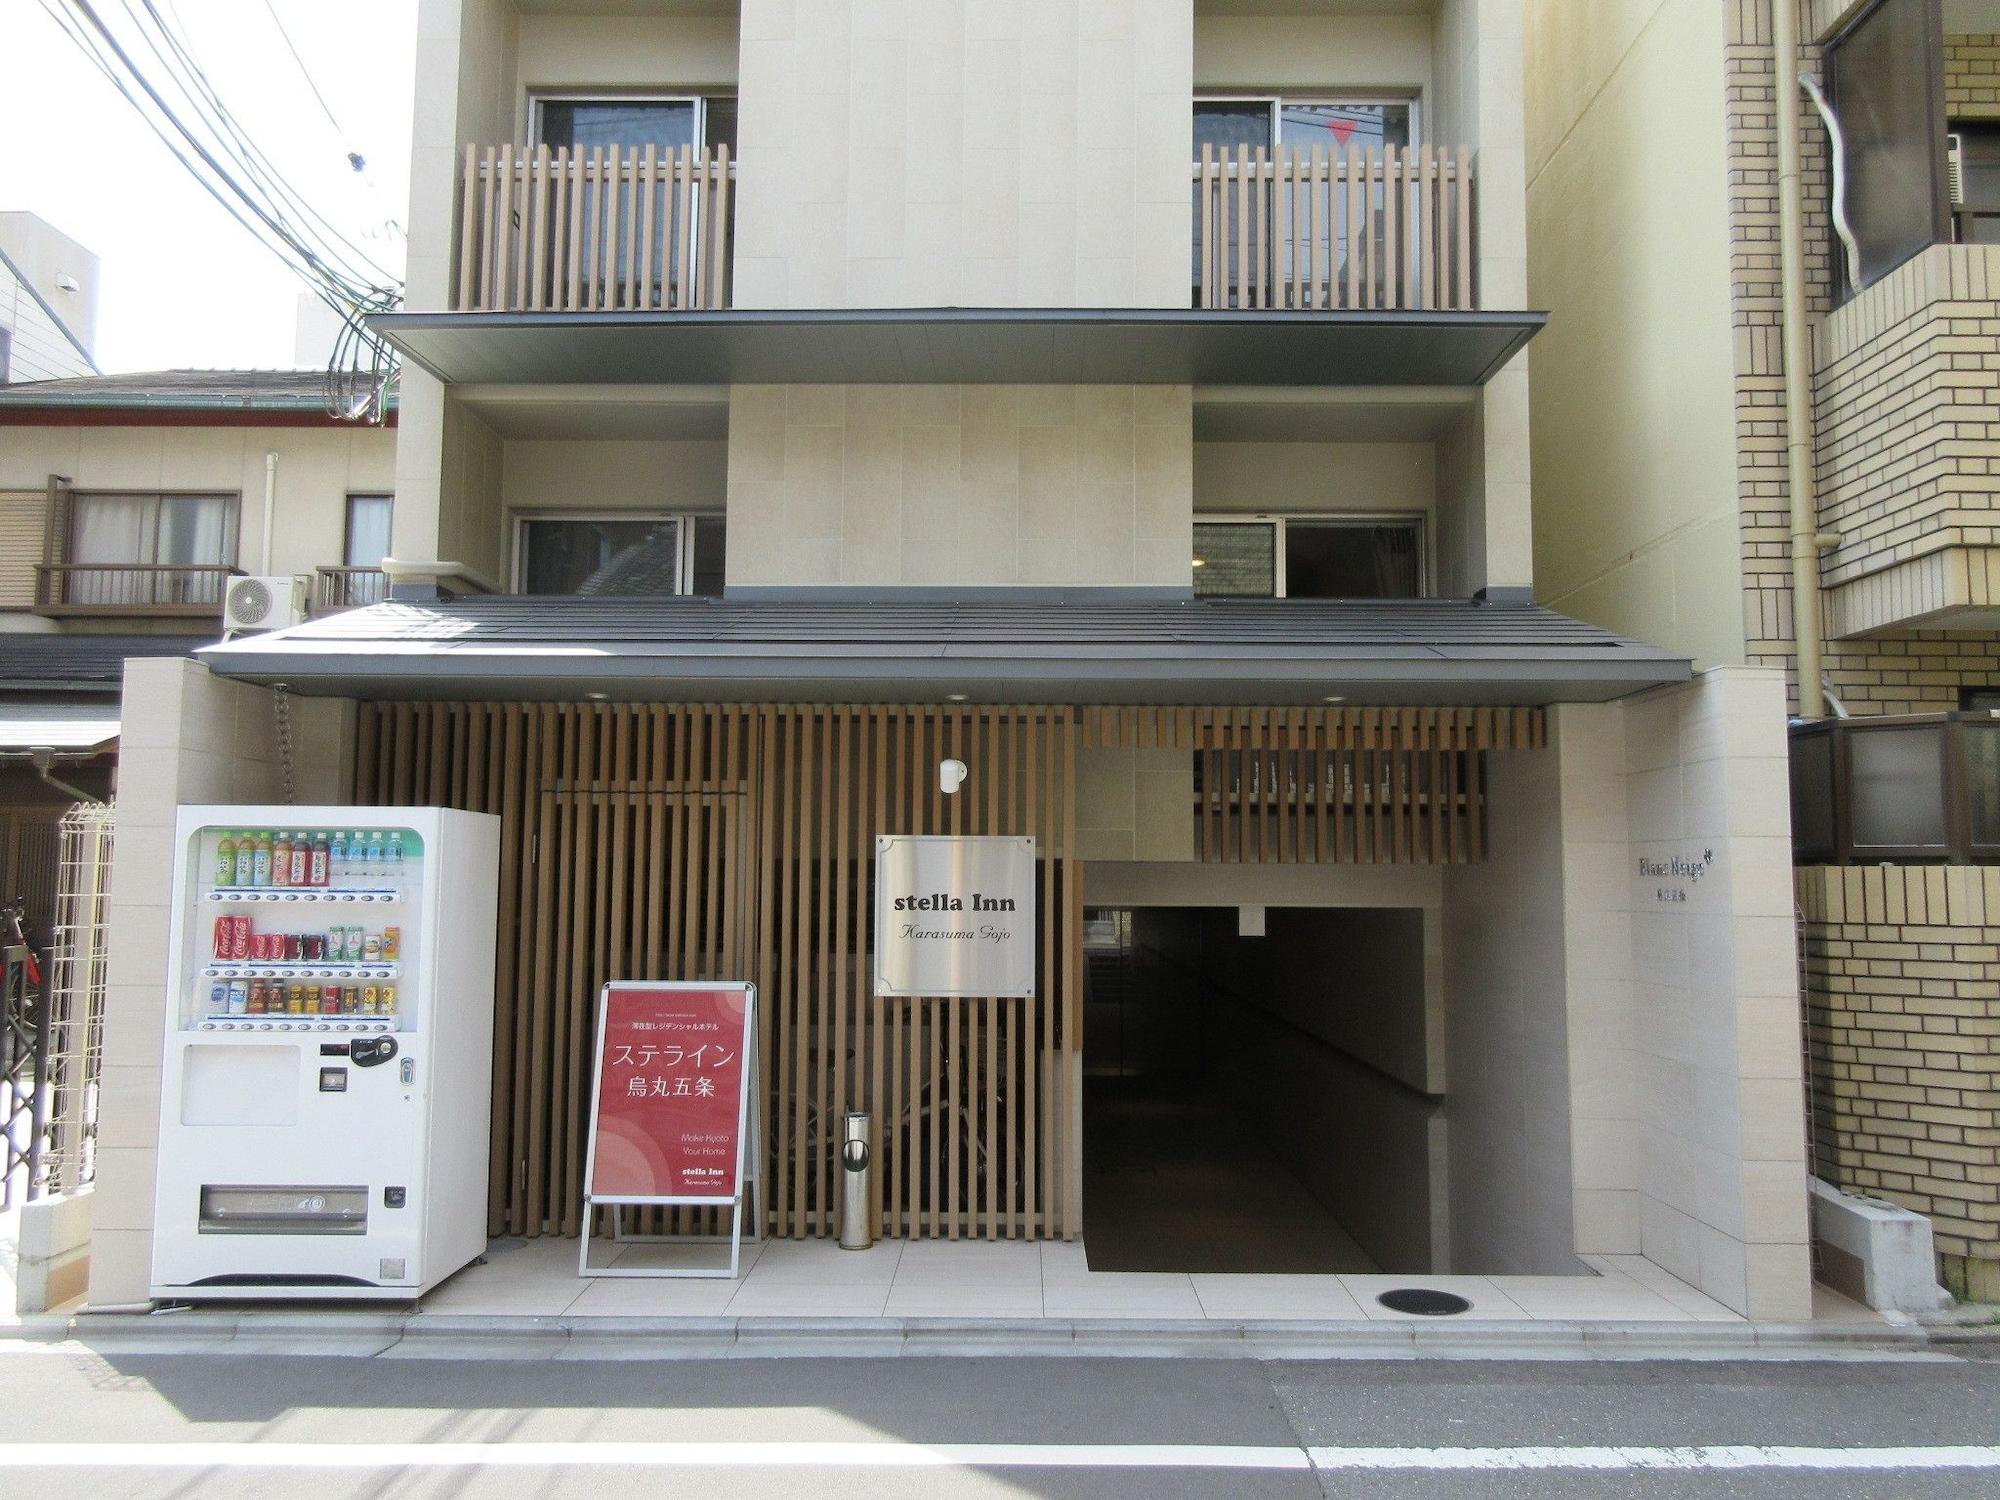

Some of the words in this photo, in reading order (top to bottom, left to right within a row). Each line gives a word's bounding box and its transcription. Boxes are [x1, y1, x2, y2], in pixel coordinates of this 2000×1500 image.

[894, 893, 963, 911] stella
[972, 893, 1016, 911] Inn
[898, 924, 974, 939] Karasuma
[980, 925, 1011, 944] Gojo
[612, 1044, 735, 1068] ステライン
[627, 1076, 715, 1097] 烏丸五条
[682, 1147, 701, 1156] Your
[702, 1147, 726, 1156] Home
[682, 1168, 706, 1176] stella
[708, 1168, 724, 1176] Inn
